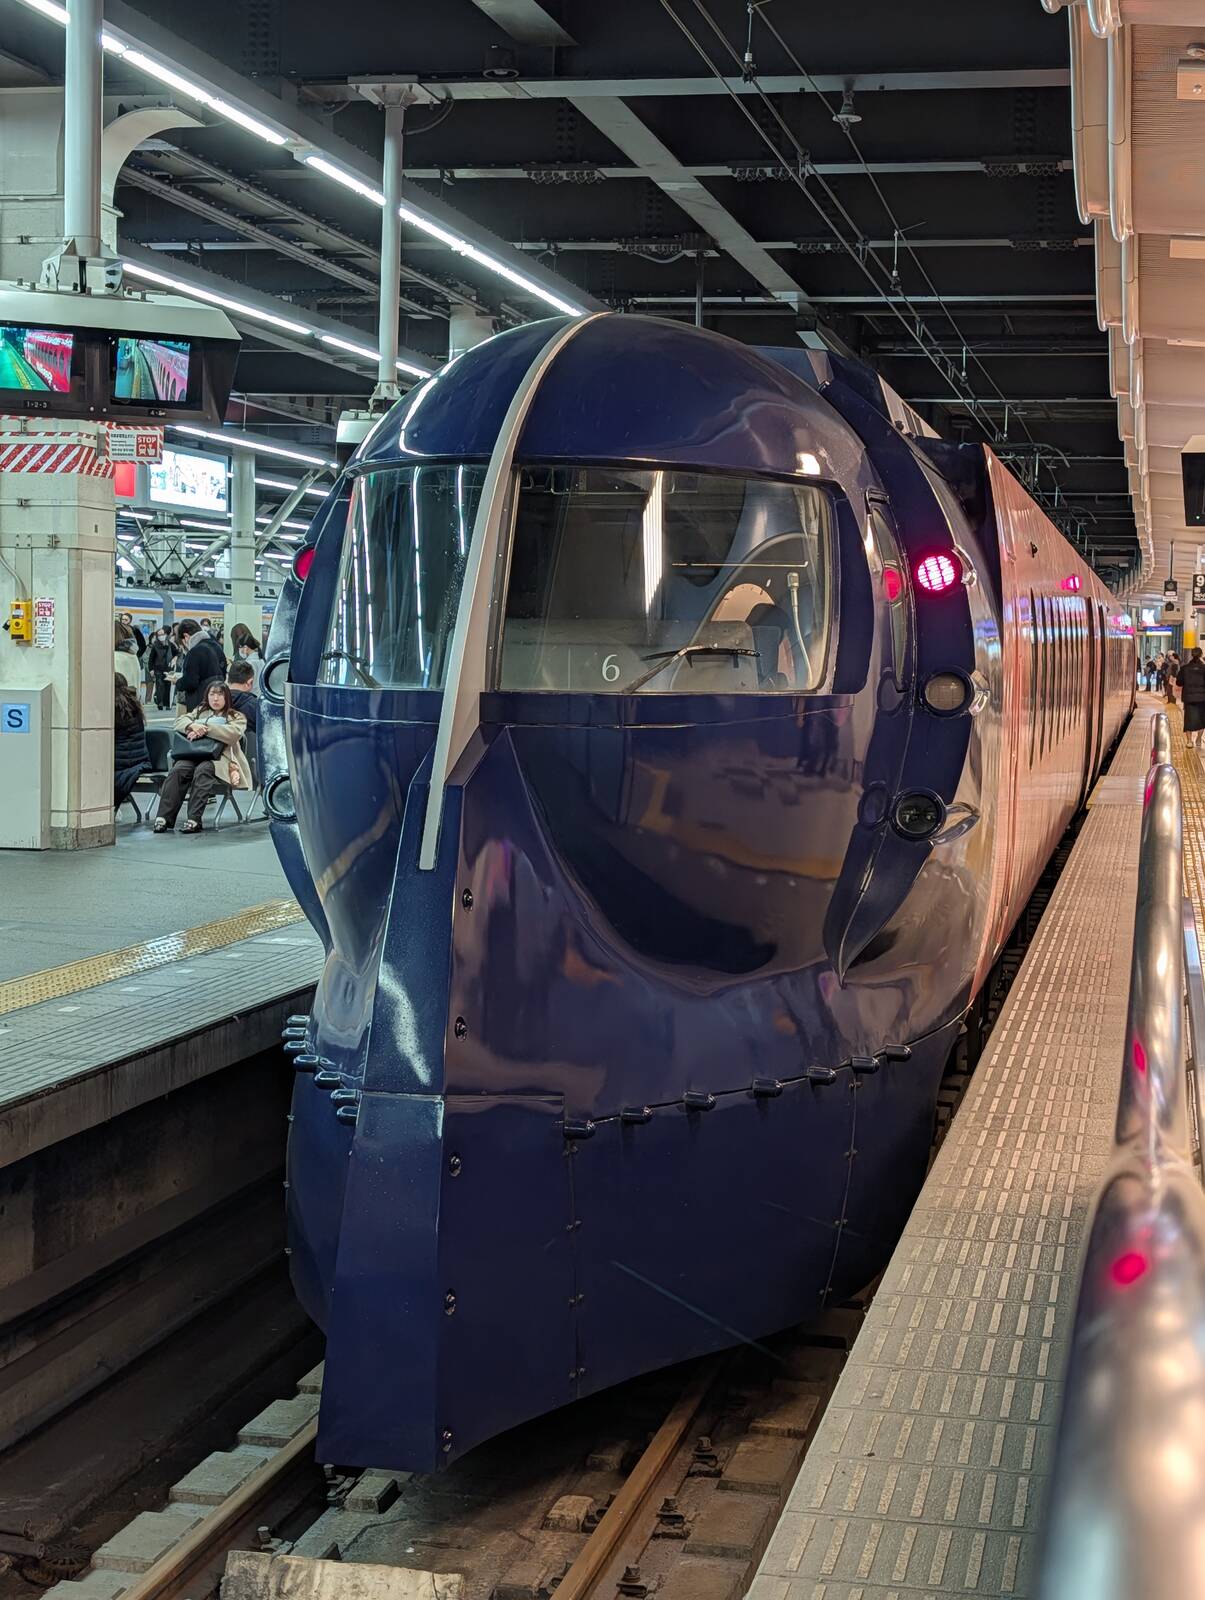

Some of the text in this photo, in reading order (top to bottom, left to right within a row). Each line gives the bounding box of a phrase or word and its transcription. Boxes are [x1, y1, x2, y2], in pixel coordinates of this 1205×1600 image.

[1196, 575, 1204, 587] 9
[602, 654, 620, 682] 6
[7, 708, 23, 728] S
